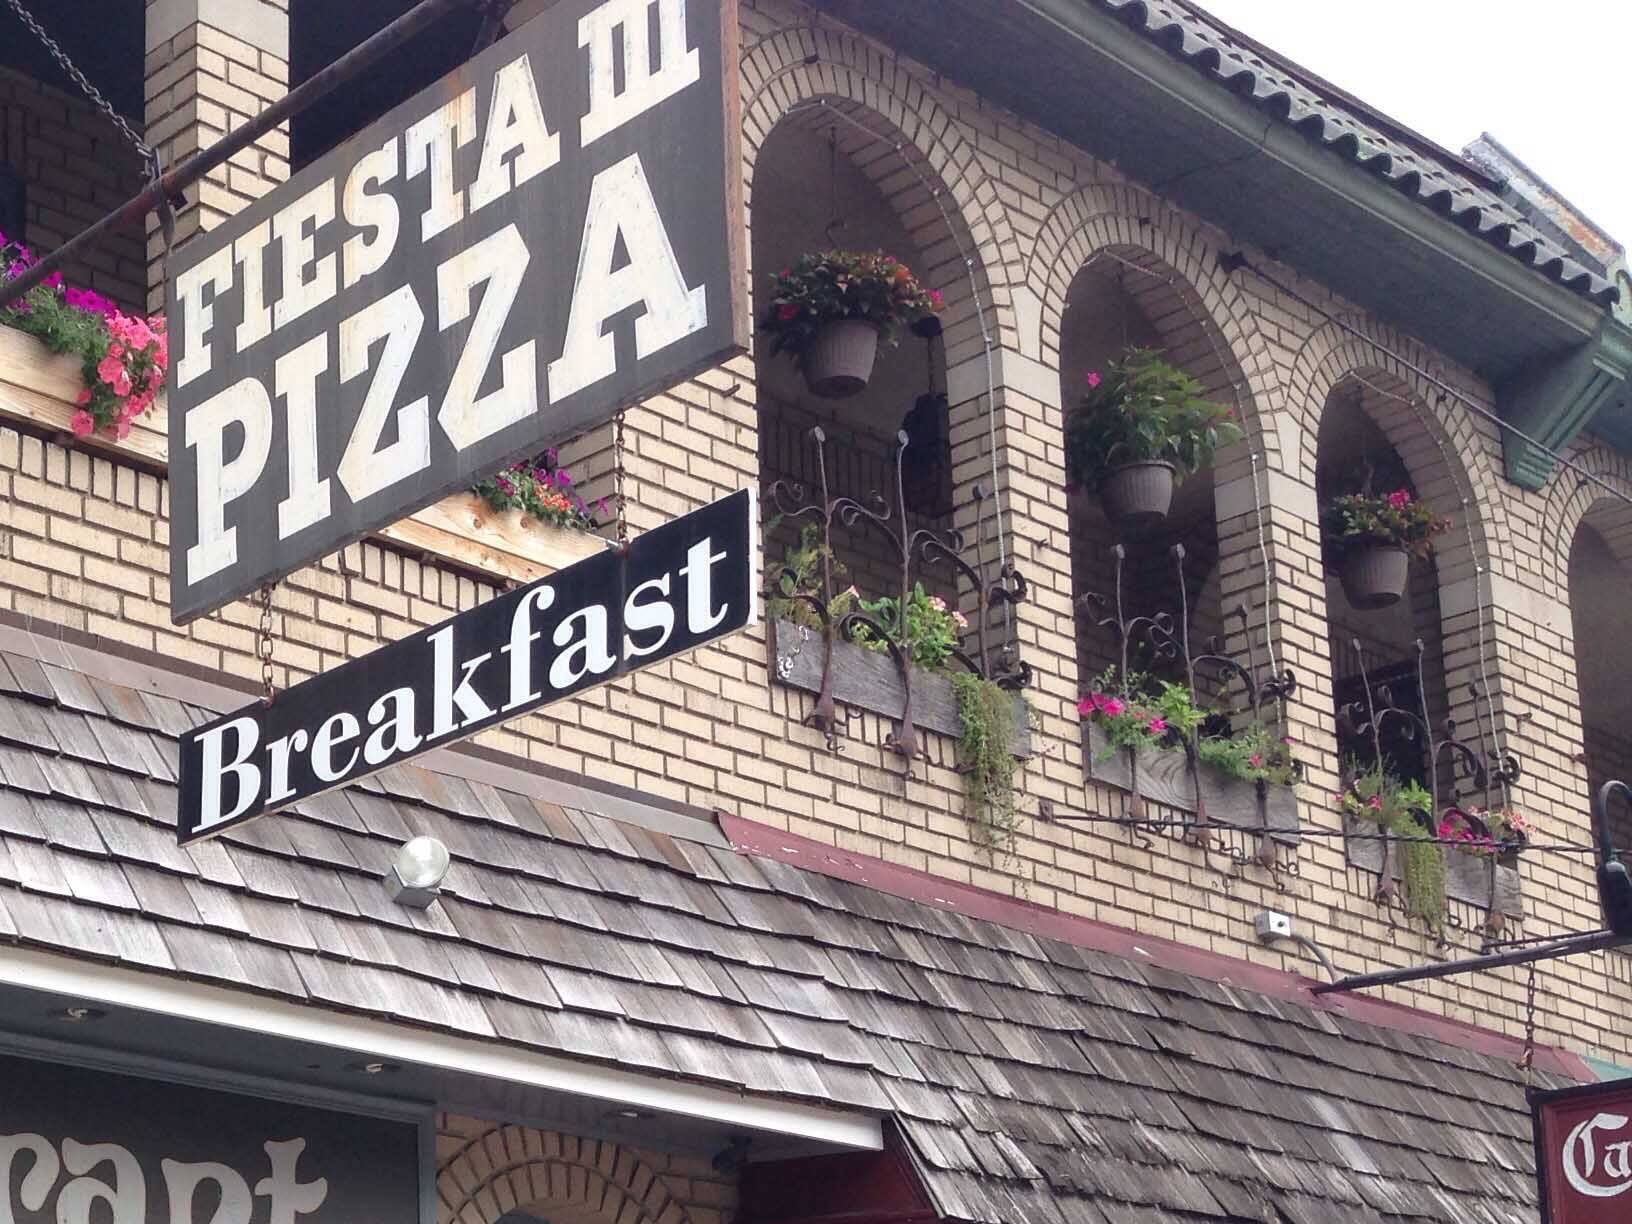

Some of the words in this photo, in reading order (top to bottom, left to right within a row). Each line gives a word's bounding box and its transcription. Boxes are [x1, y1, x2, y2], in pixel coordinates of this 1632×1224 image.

[176, 54, 560, 388] FIESTA
[578, 0, 700, 148] III
[186, 152, 707, 586] PIZZA
[191, 536, 730, 835] Breakfast
